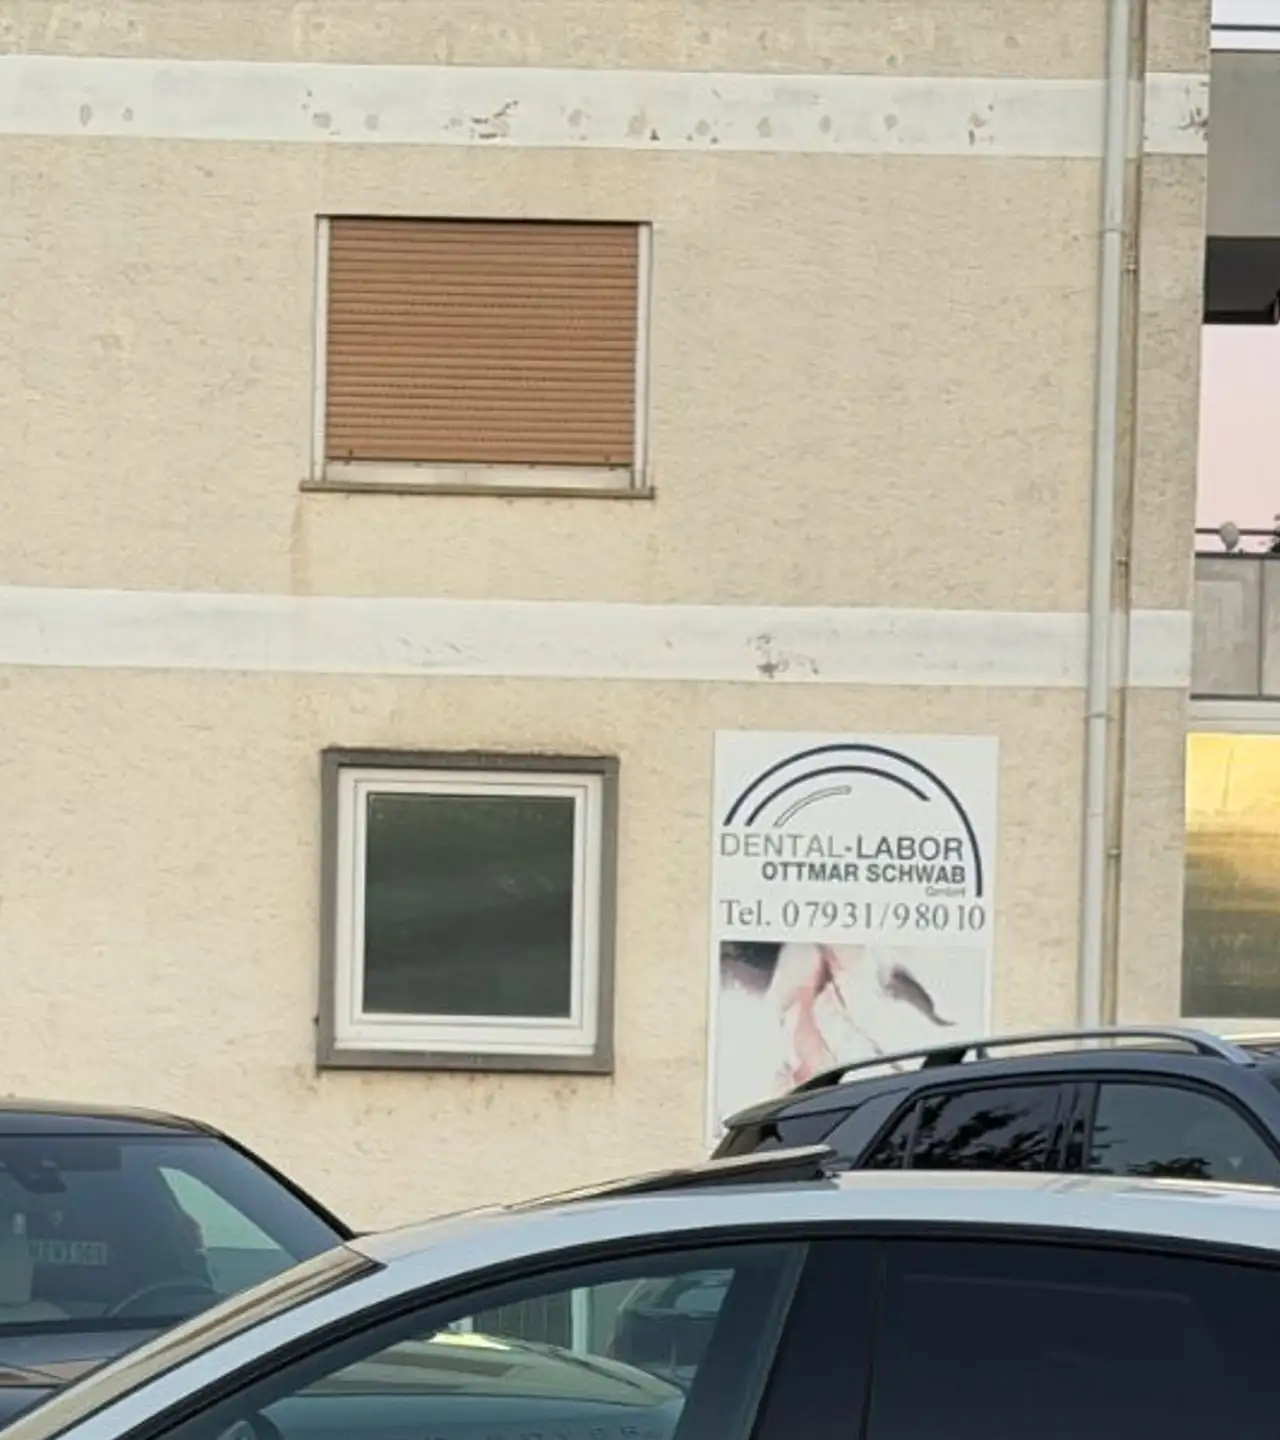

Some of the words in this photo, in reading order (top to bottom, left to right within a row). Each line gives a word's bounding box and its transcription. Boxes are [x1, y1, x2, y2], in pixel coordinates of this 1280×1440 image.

[761, 861, 860, 882] OTTMAR
[865, 863, 966, 884] SCHWAB
[719, 899, 771, 926] Tel.
